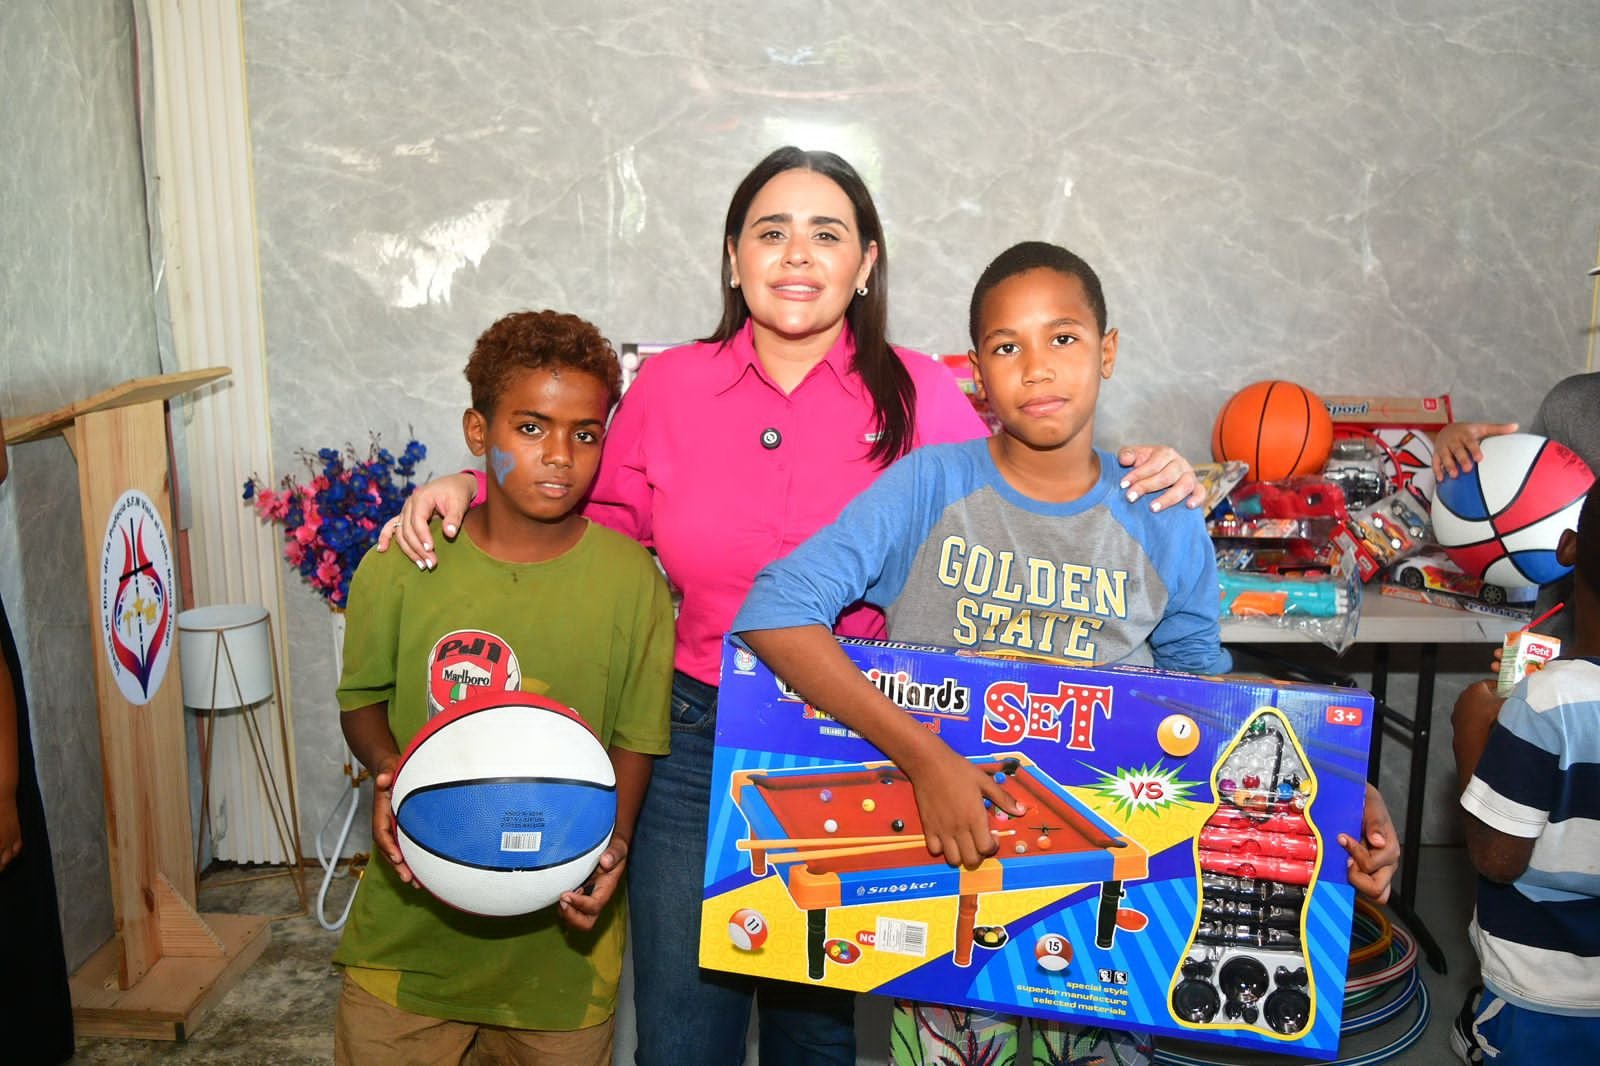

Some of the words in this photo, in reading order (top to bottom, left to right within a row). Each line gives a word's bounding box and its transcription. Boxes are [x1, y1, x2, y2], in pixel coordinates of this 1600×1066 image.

[938, 535, 1129, 619] GOLDEN
[953, 597, 1104, 660] STATE
[1529, 644, 1551, 658] Petit
[443, 668, 490, 686] Marlboro
[981, 680, 1113, 752] SET
[1333, 709, 1357, 723] 3+
[1129, 781, 1165, 801] VS
[867, 881, 938, 895] Snooker
[746, 917, 760, 932] 11
[1048, 940, 1060, 952] 15
[1016, 983, 1060, 997] superior
[1061, 991, 1129, 1006] manufacture
[1066, 980, 1101, 992] special
[1103, 984, 1129, 997] style
[1033, 996, 1077, 1010] selected
[1078, 1003, 1127, 1016] materials
